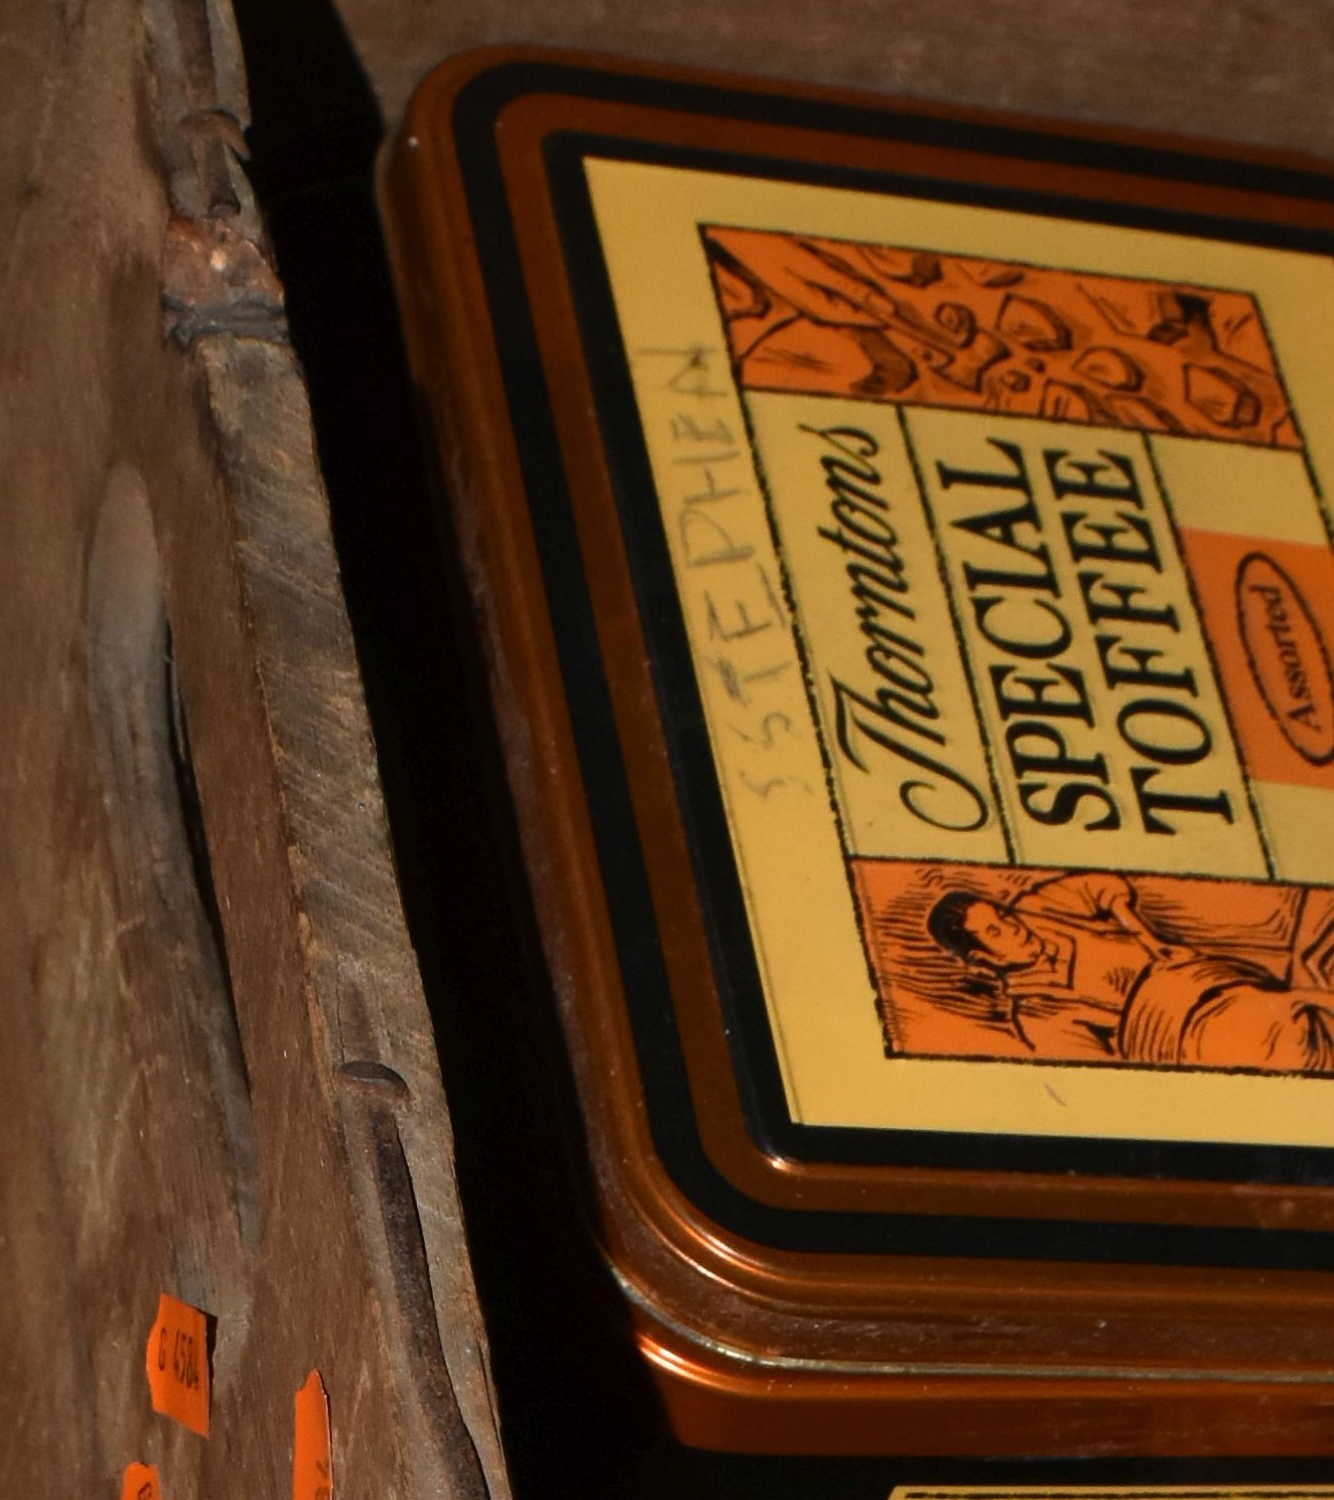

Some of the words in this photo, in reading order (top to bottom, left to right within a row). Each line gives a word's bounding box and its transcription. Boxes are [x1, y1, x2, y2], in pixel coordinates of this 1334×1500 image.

[797, 420, 990, 834] Thorntons
[938, 435, 1122, 833] SPECIAL
[1045, 449, 1234, 837] TOFFEE
[1249, 583, 1324, 737] Assorted
[172, 1329, 200, 1392] 4584
